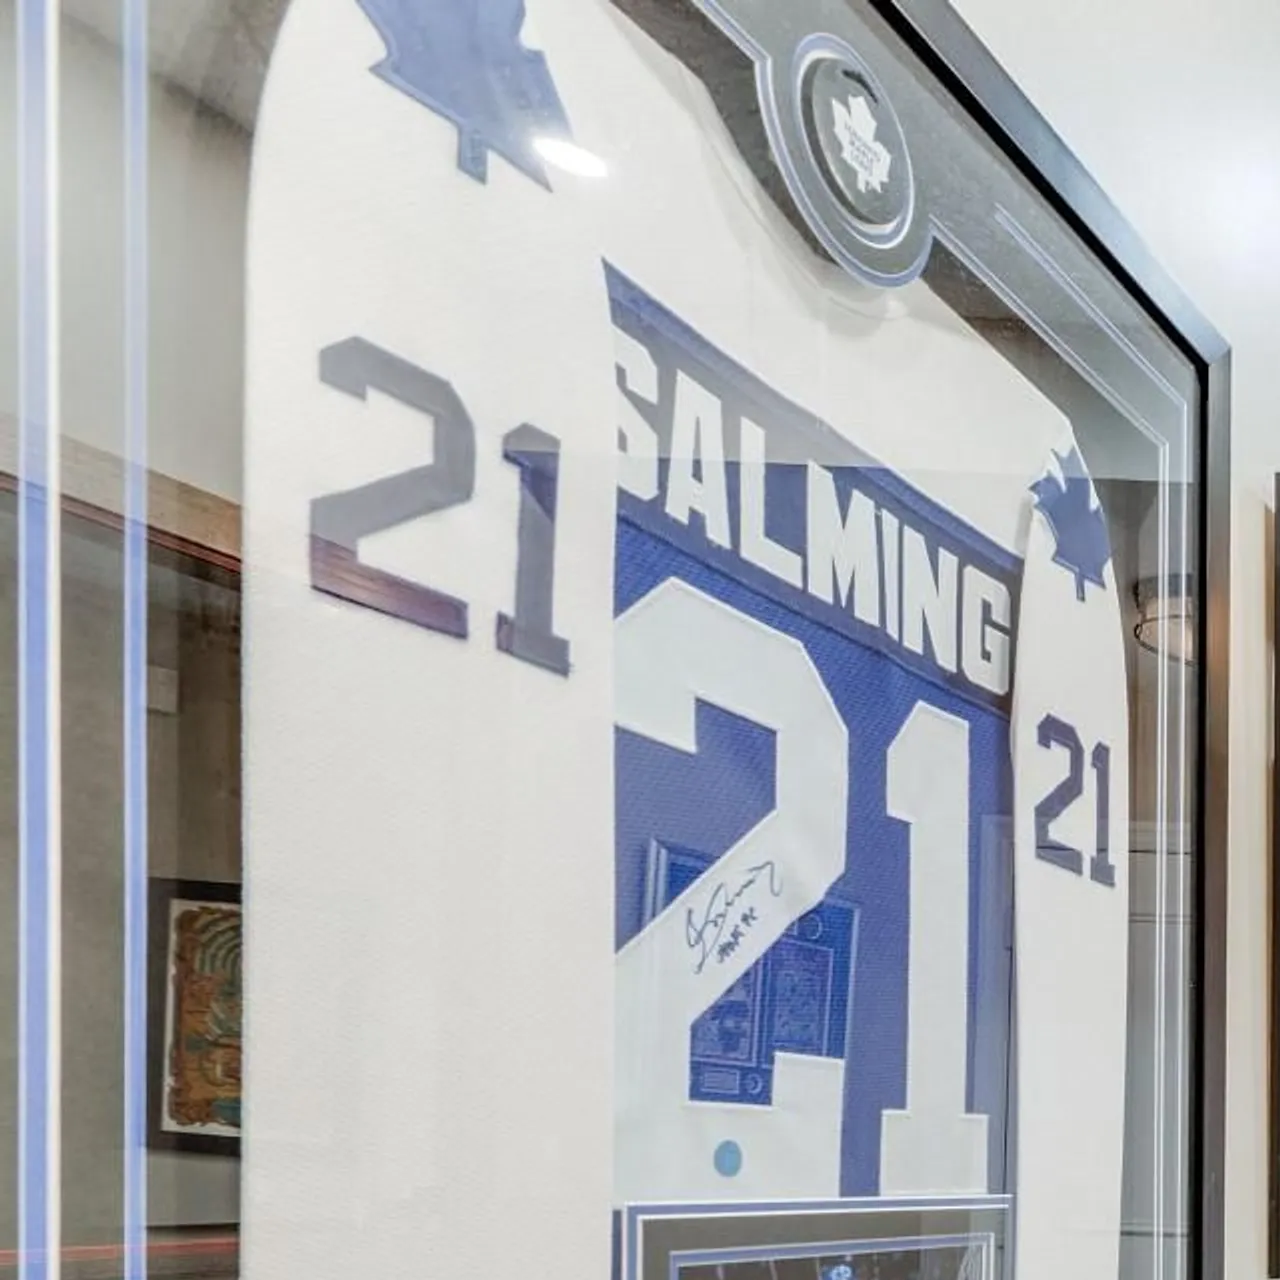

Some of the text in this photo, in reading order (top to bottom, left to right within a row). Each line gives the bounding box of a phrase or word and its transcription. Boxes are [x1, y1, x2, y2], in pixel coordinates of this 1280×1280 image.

[309, 336, 570, 677] 21
[612, 323, 1012, 696] SALMING
[613, 576, 989, 1200] 21
[1034, 713, 1116, 887] 21
